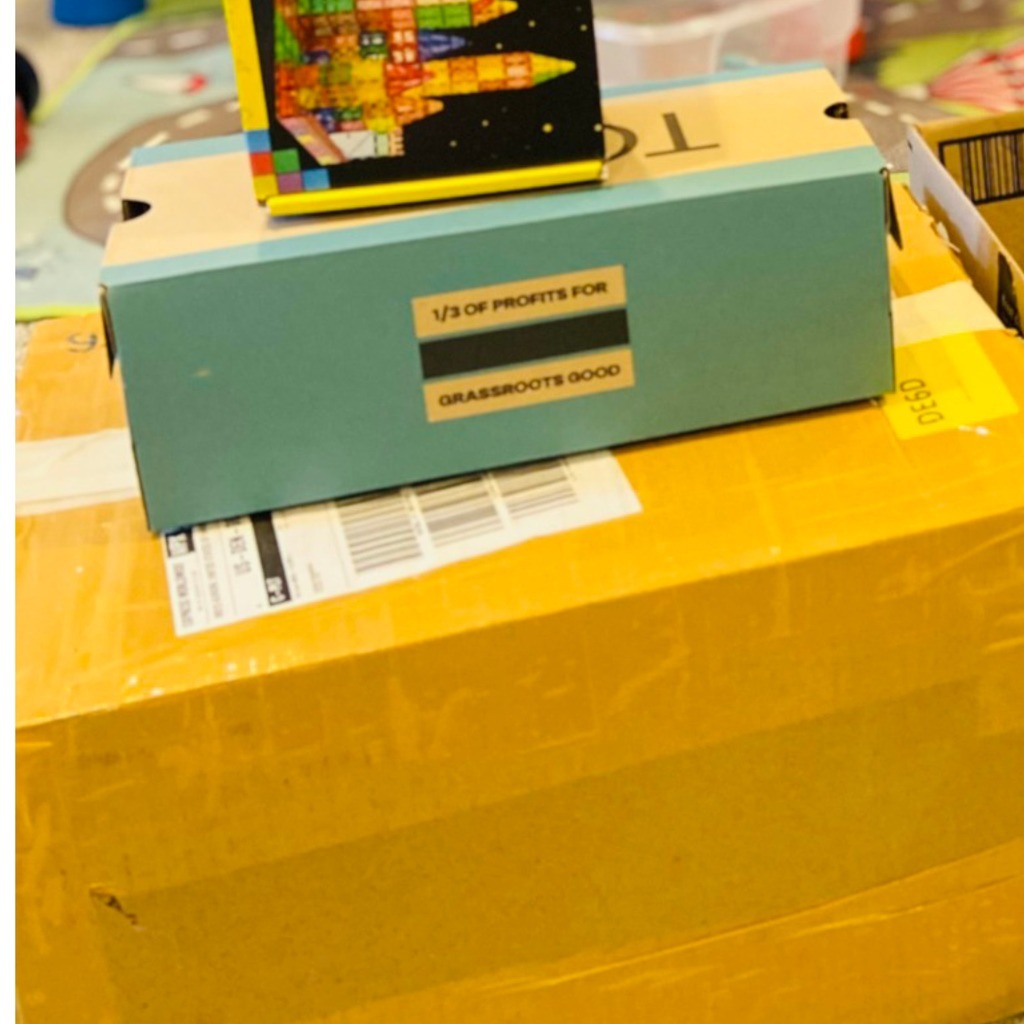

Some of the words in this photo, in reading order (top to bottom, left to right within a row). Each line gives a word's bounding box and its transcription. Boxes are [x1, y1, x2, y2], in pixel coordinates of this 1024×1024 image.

[432, 304, 461, 323] 1/3
[464, 300, 488, 317] OF
[492, 287, 568, 312] PROFITS
[571, 281, 608, 299] FOR
[438, 373, 564, 407] GRASSROOTS
[568, 364, 621, 383] GOOD
